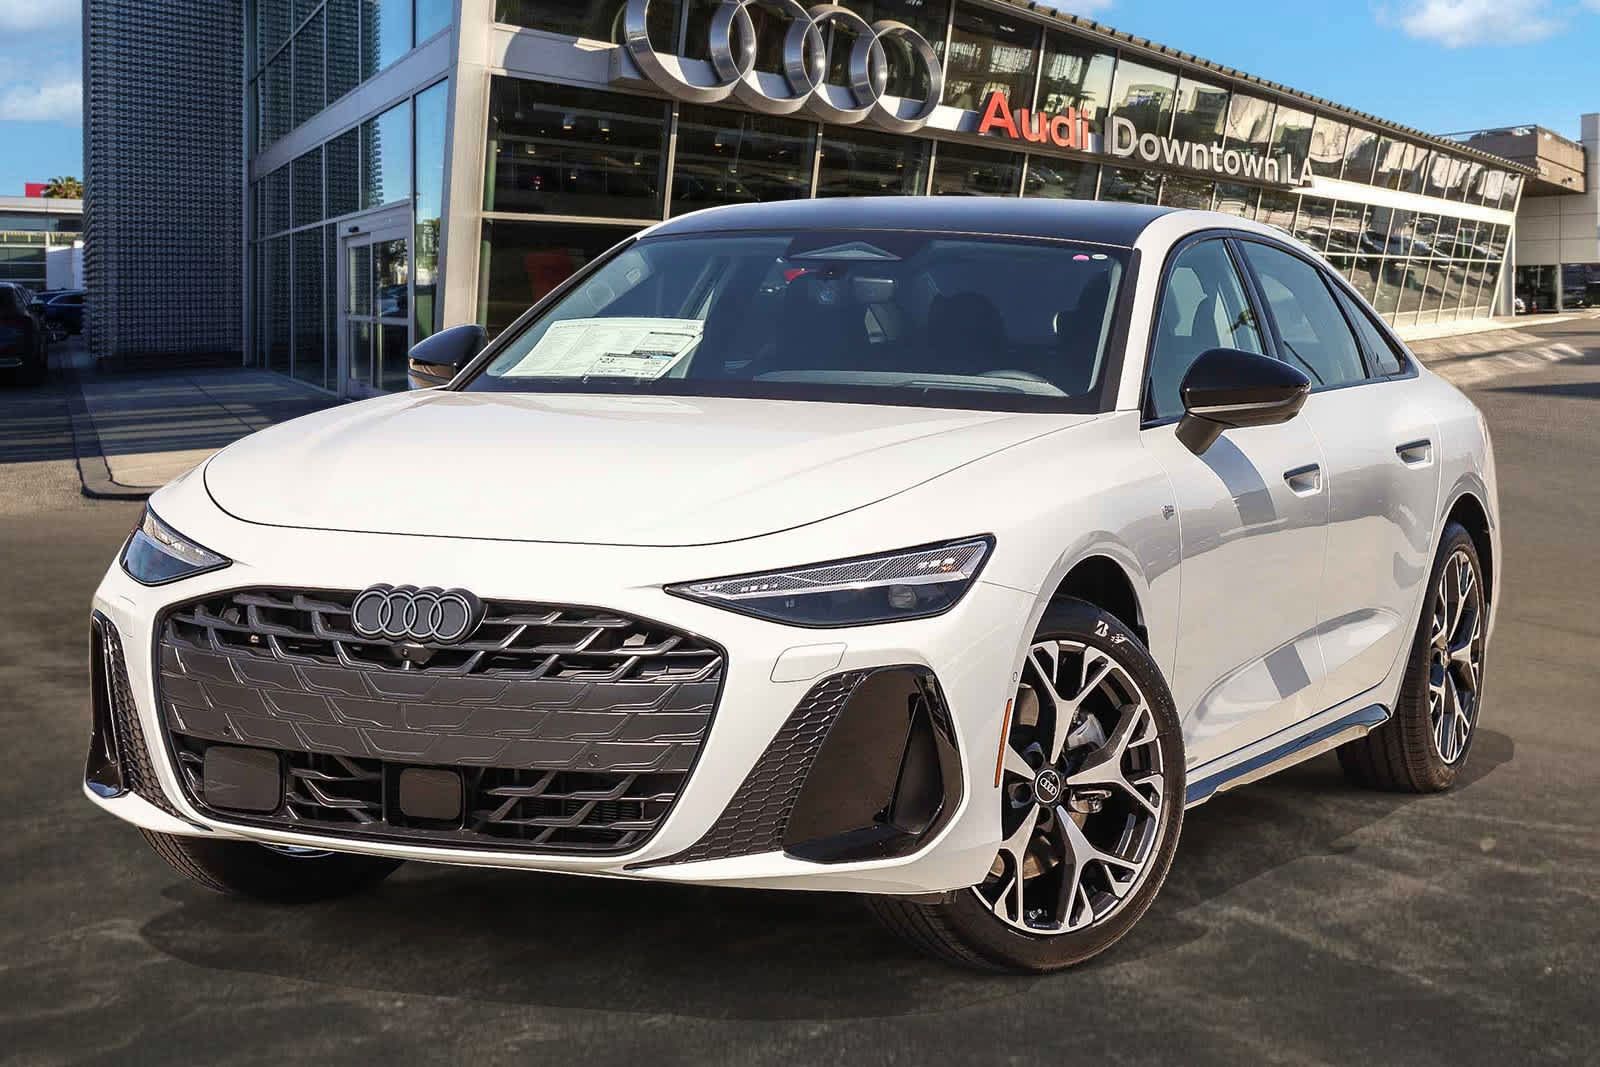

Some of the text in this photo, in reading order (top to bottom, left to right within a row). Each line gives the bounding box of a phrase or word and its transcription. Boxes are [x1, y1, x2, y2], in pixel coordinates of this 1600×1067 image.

[978, 91, 1316, 188] Audi Downtown LA
